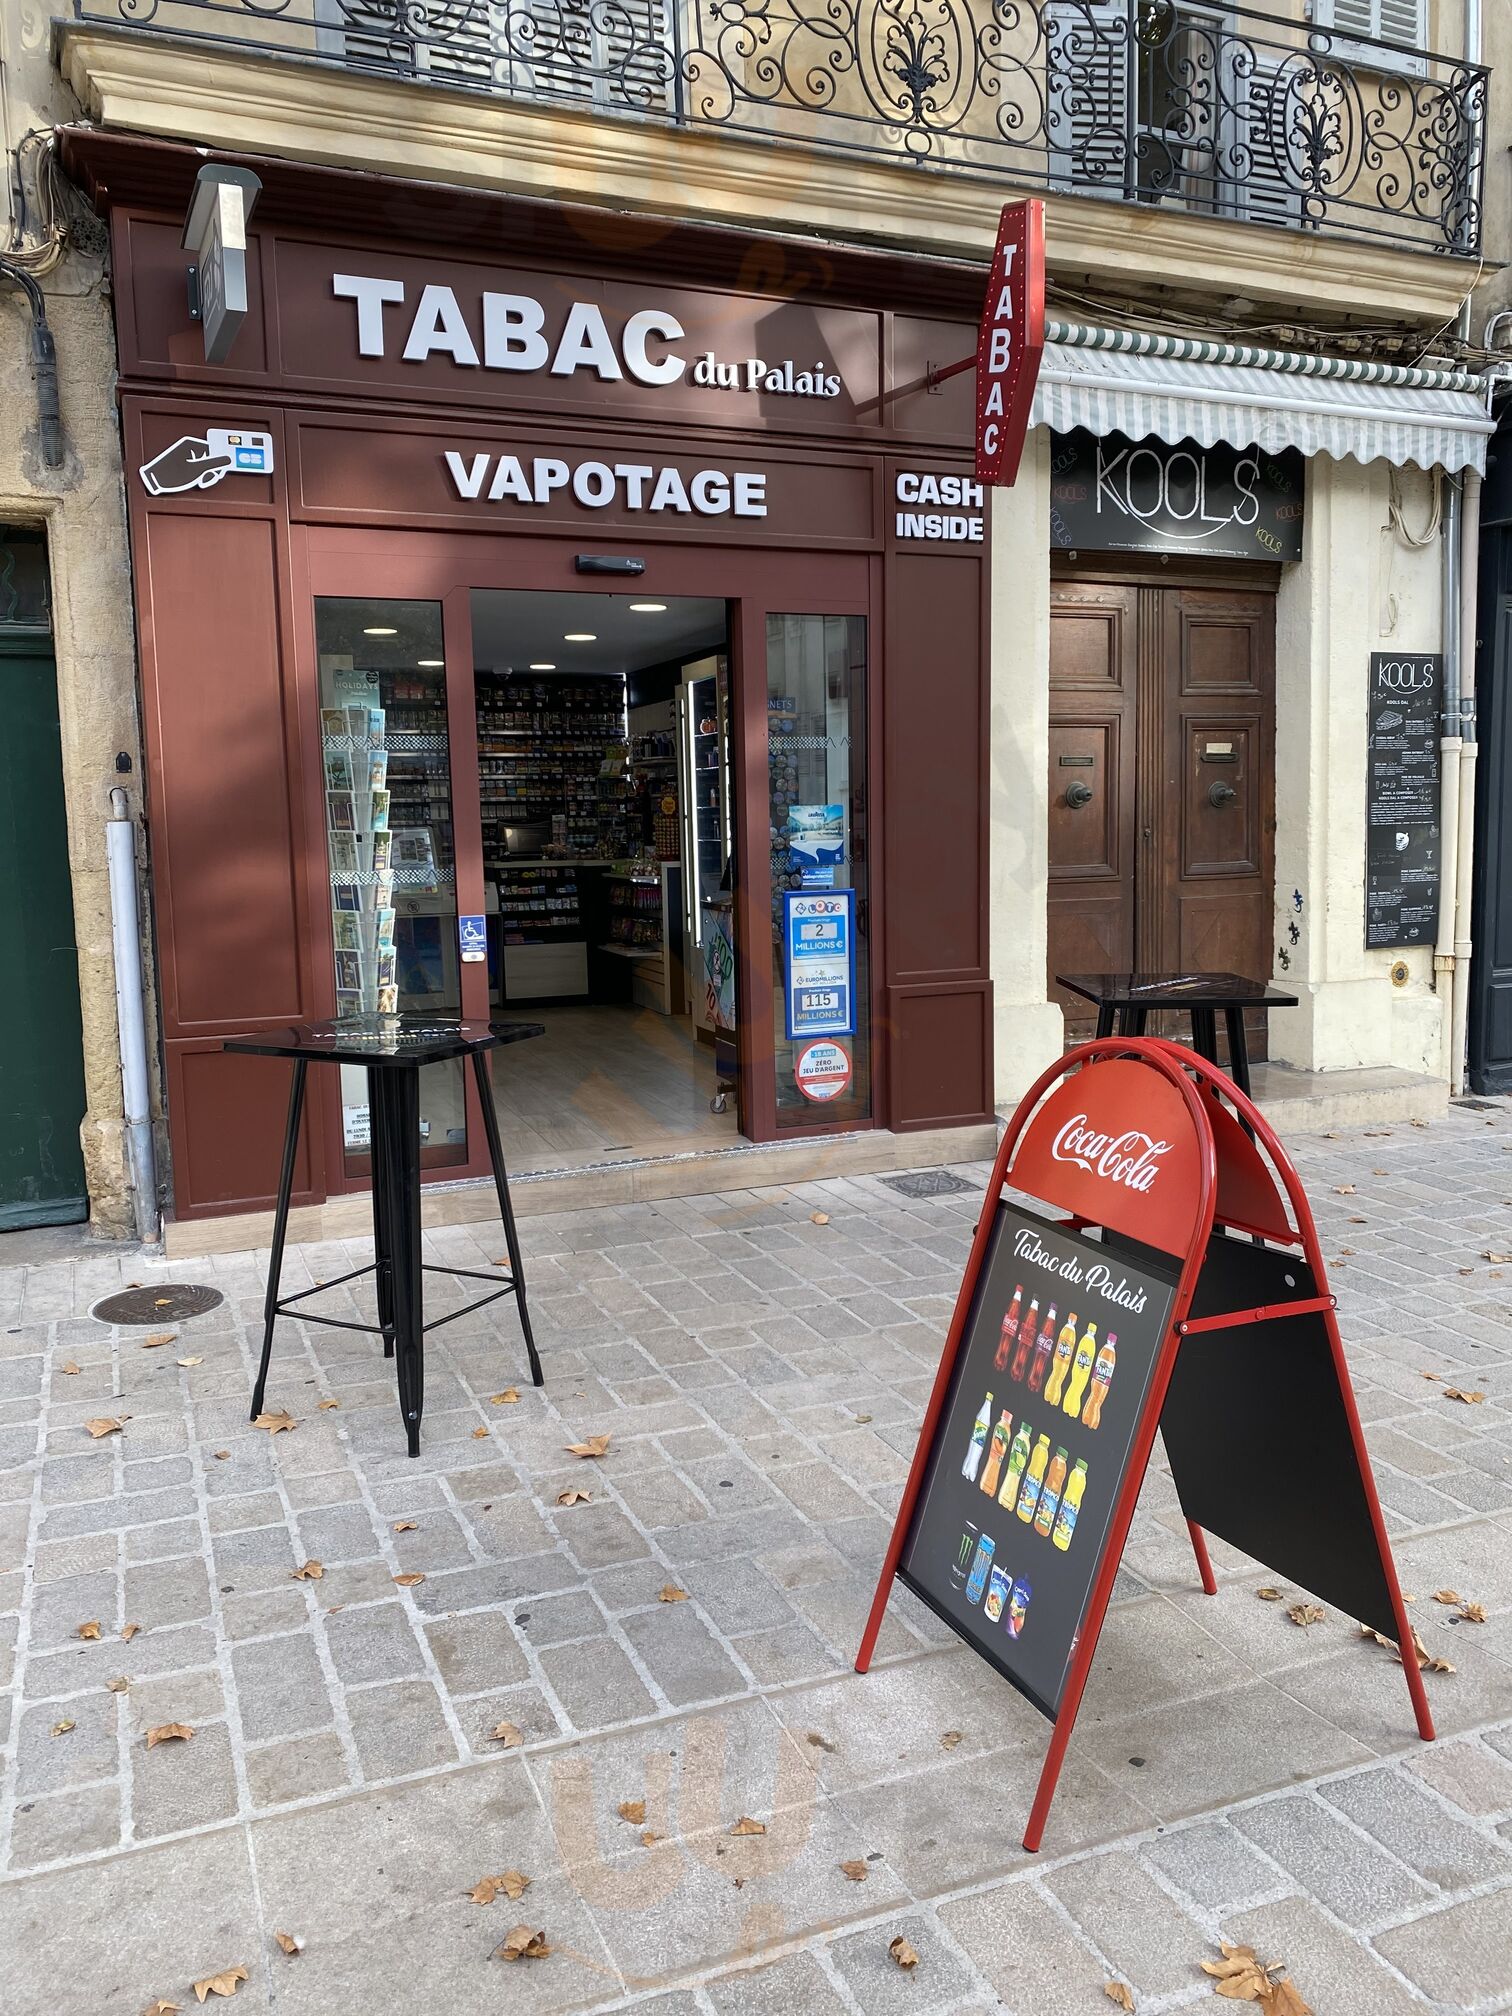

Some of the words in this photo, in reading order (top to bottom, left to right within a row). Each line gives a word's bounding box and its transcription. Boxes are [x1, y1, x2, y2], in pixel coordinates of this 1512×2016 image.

[333, 273, 686, 386] TABAC
[694, 352, 739, 387] du
[747, 359, 841, 398] Palais
[984, 244, 1017, 455] TABAC
[1051, 447, 1078, 475] OOLS
[444, 451, 768, 517] VAPOTAGE
[896, 474, 983, 508] CASH
[1096, 446, 1260, 525] KOOLS
[896, 513, 984, 541] INSIDE
[1255, 527, 1282, 554] KOOLS
[335, 681, 378, 690] HOLIDAYS
[1378, 662, 1434, 688] KOOLS
[815, 923, 824, 937] 2
[795, 941, 836, 951] MILLIONS
[836, 940, 843, 948] €
[805, 975, 844, 983] EUROMILLIONS
[806, 993, 831, 1007] 115
[796, 1011, 837, 1021] MILLIONS
[1052, 1114, 1175, 1193] Coca-Cola
[1014, 1229, 1059, 1272] Tabac
[1059, 1256, 1083, 1284] du
[1085, 1264, 1148, 1314] Palais
